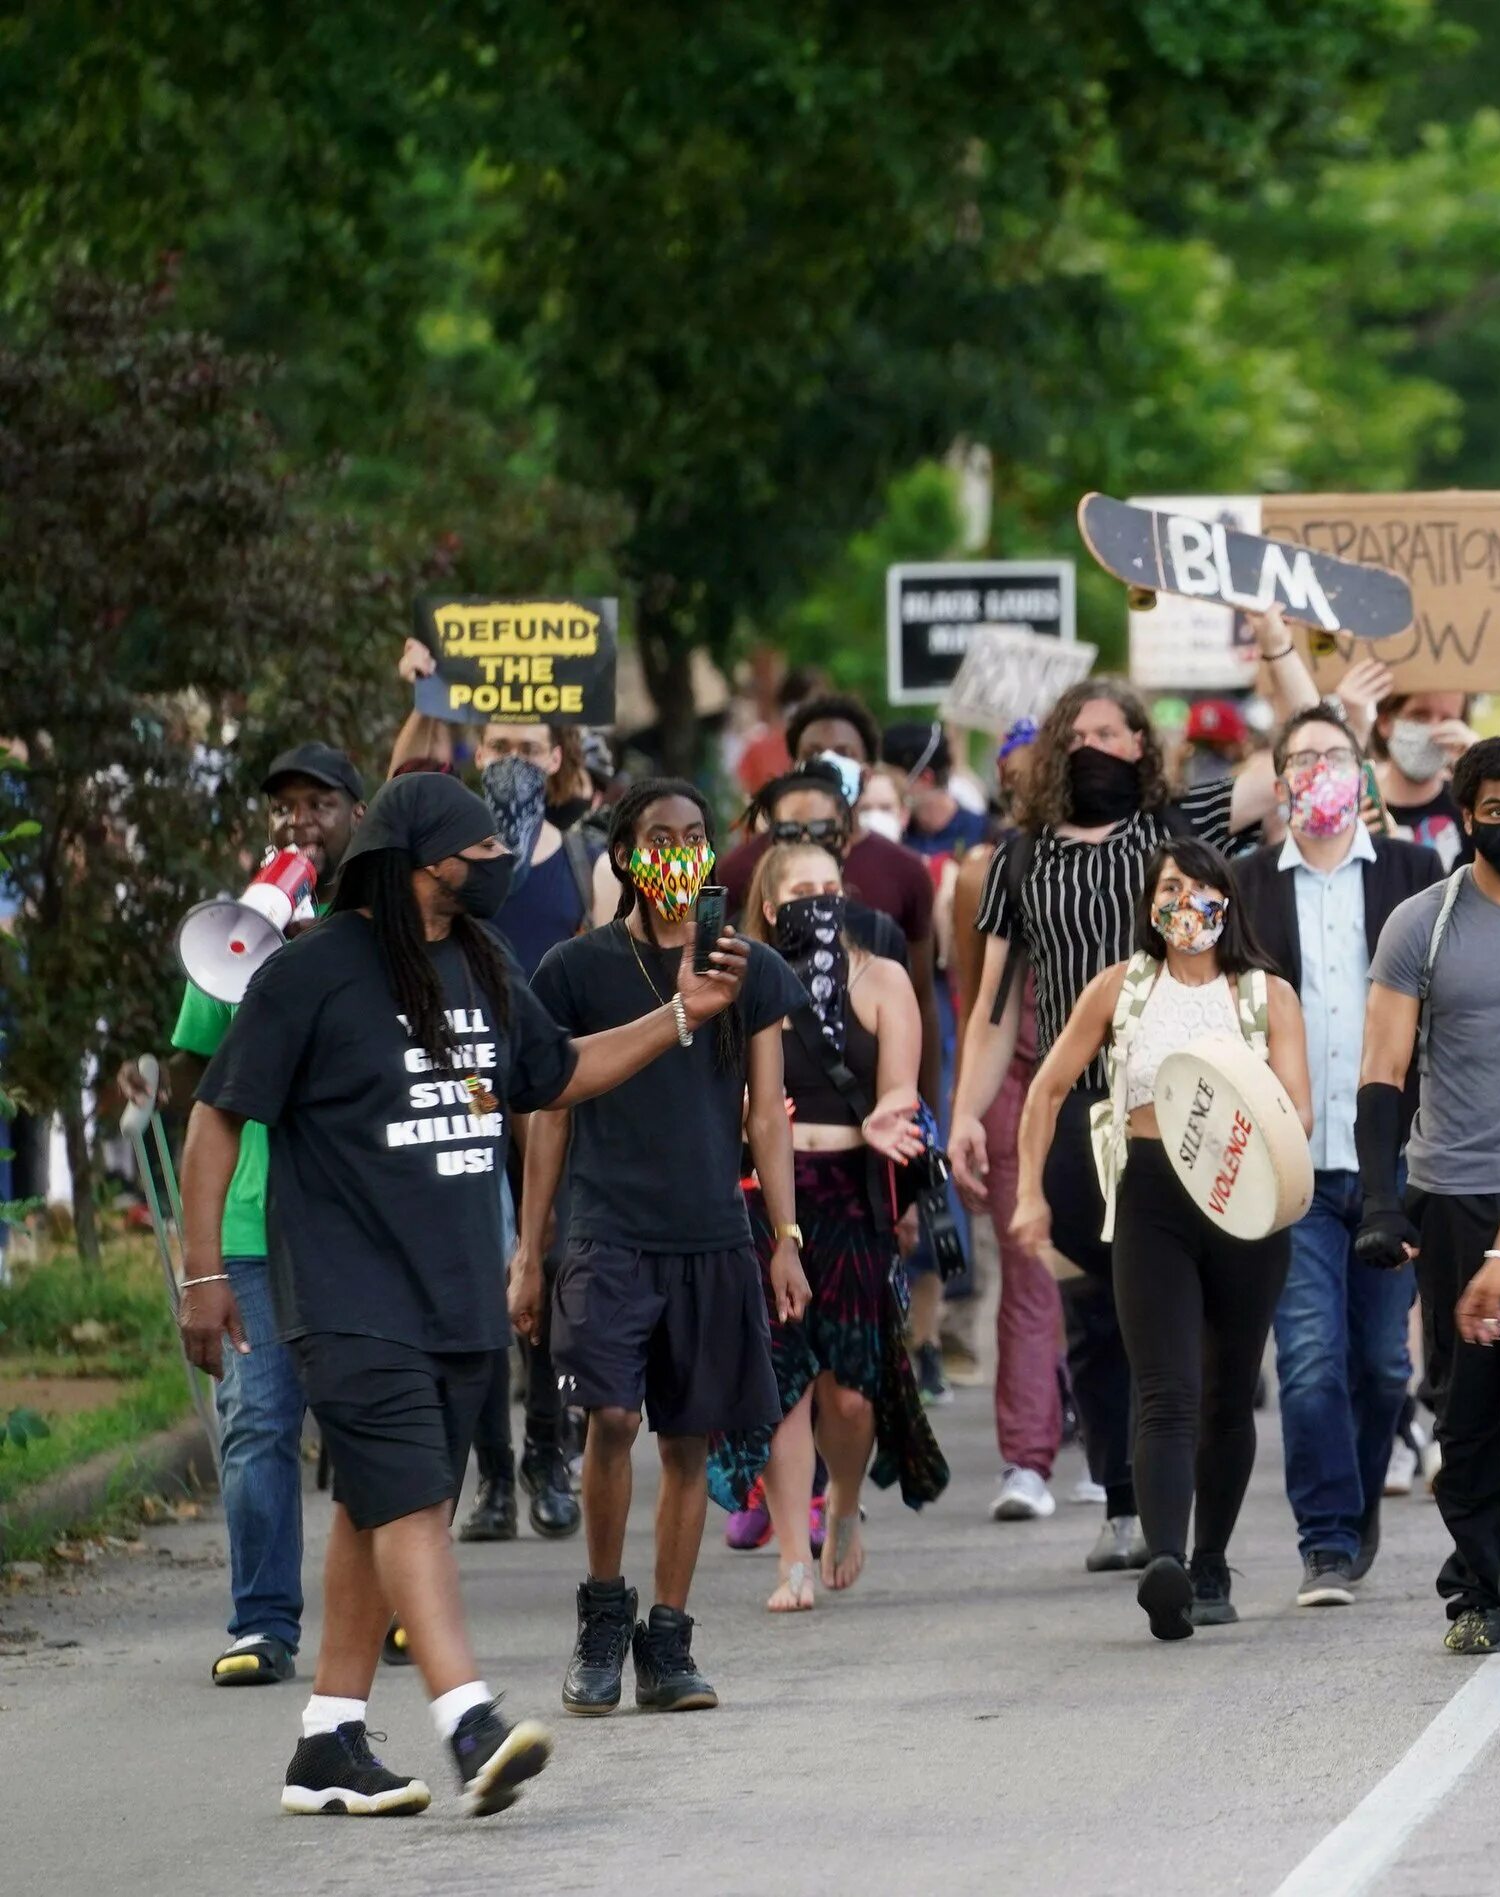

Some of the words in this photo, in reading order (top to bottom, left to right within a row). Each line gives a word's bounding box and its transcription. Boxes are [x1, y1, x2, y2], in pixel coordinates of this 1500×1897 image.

[1167, 515, 1340, 631] BLM
[903, 590, 981, 622] BLACK
[984, 588, 1060, 621] LIVES
[443, 618, 591, 641] DEFUND
[478, 656, 553, 684] THE
[450, 684, 583, 713] POLICE
[404, 1043, 497, 1073] GNE
[1179, 1076, 1215, 1171] SILENCE
[436, 1147, 494, 1177] US!
[1208, 1109, 1253, 1215] VIOLENCE
